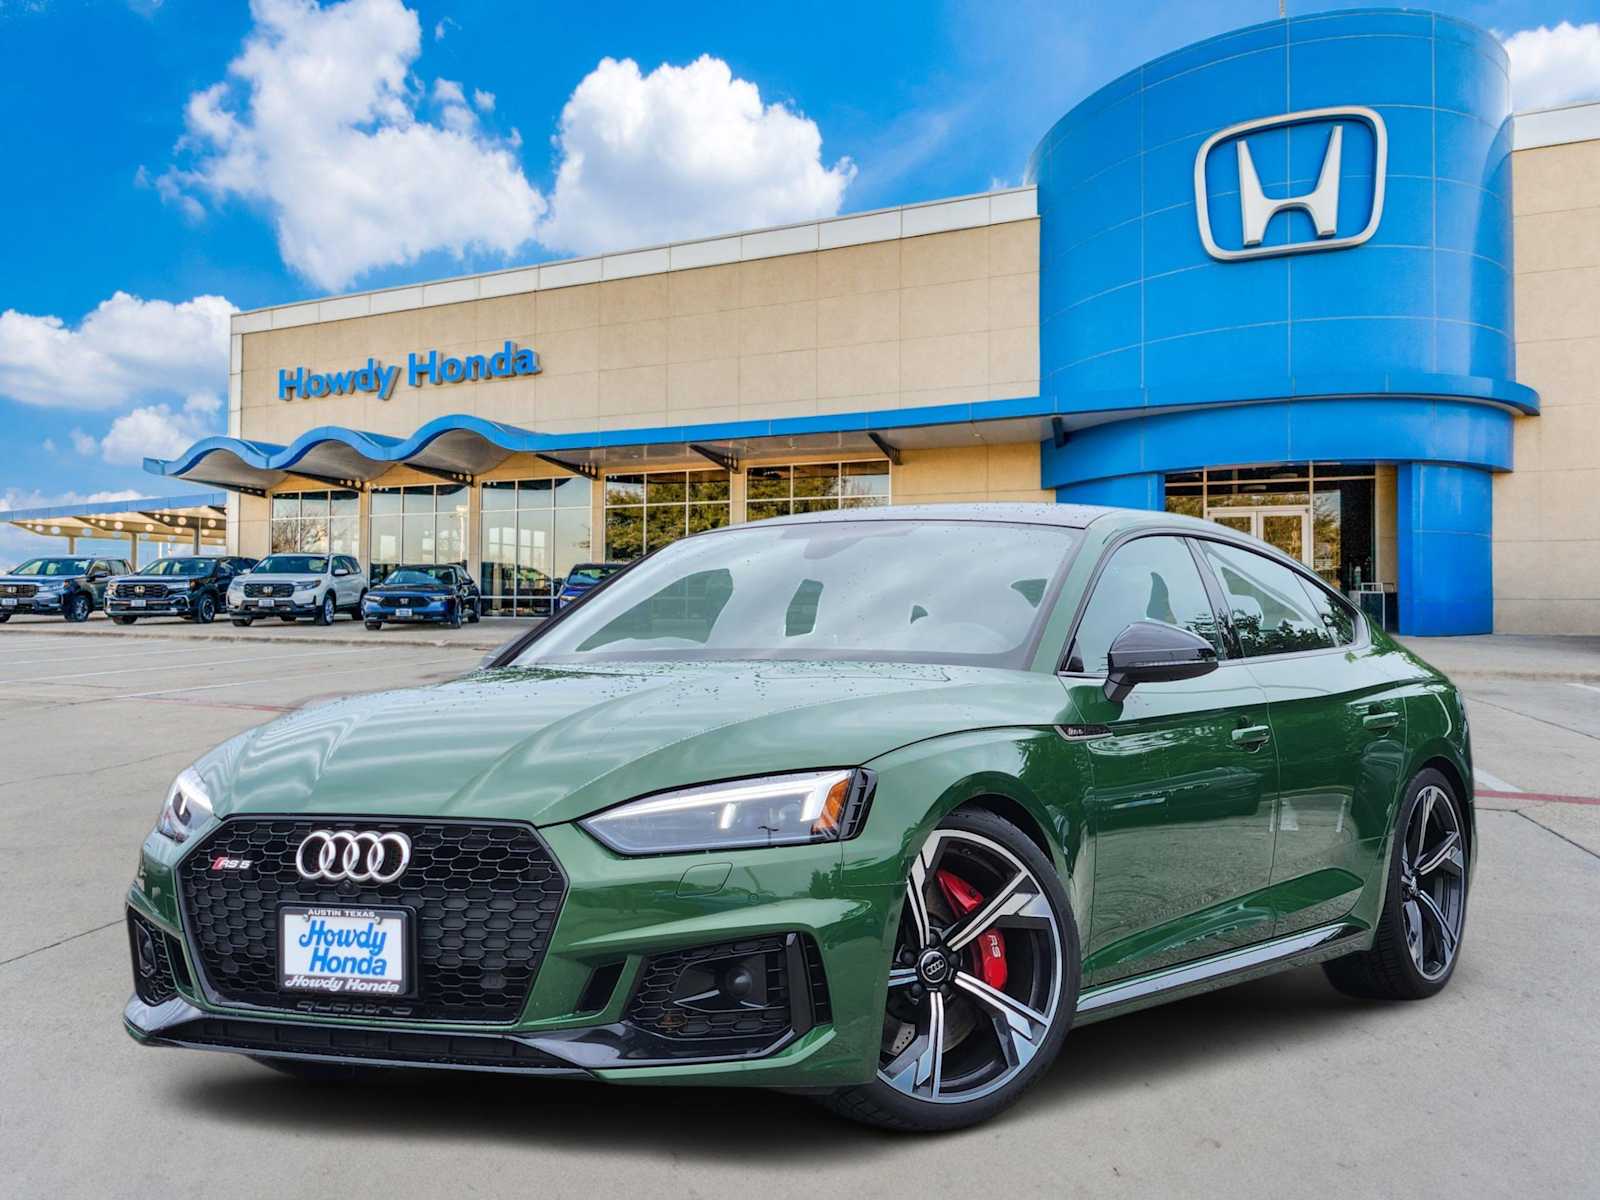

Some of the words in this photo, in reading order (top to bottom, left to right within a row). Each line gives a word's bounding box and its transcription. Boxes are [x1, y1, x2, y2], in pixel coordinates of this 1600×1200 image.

[278, 357, 401, 400] Howdy
[408, 340, 542, 388] Honda
[308, 908, 341, 917] AUSTIN
[345, 910, 375, 918] TEXAS
[299, 919, 387, 956] Howdy
[988, 934, 1001, 958] RS
[309, 946, 388, 976] Honda
[284, 975, 344, 991] Howdy
[344, 979, 401, 993] Honda
